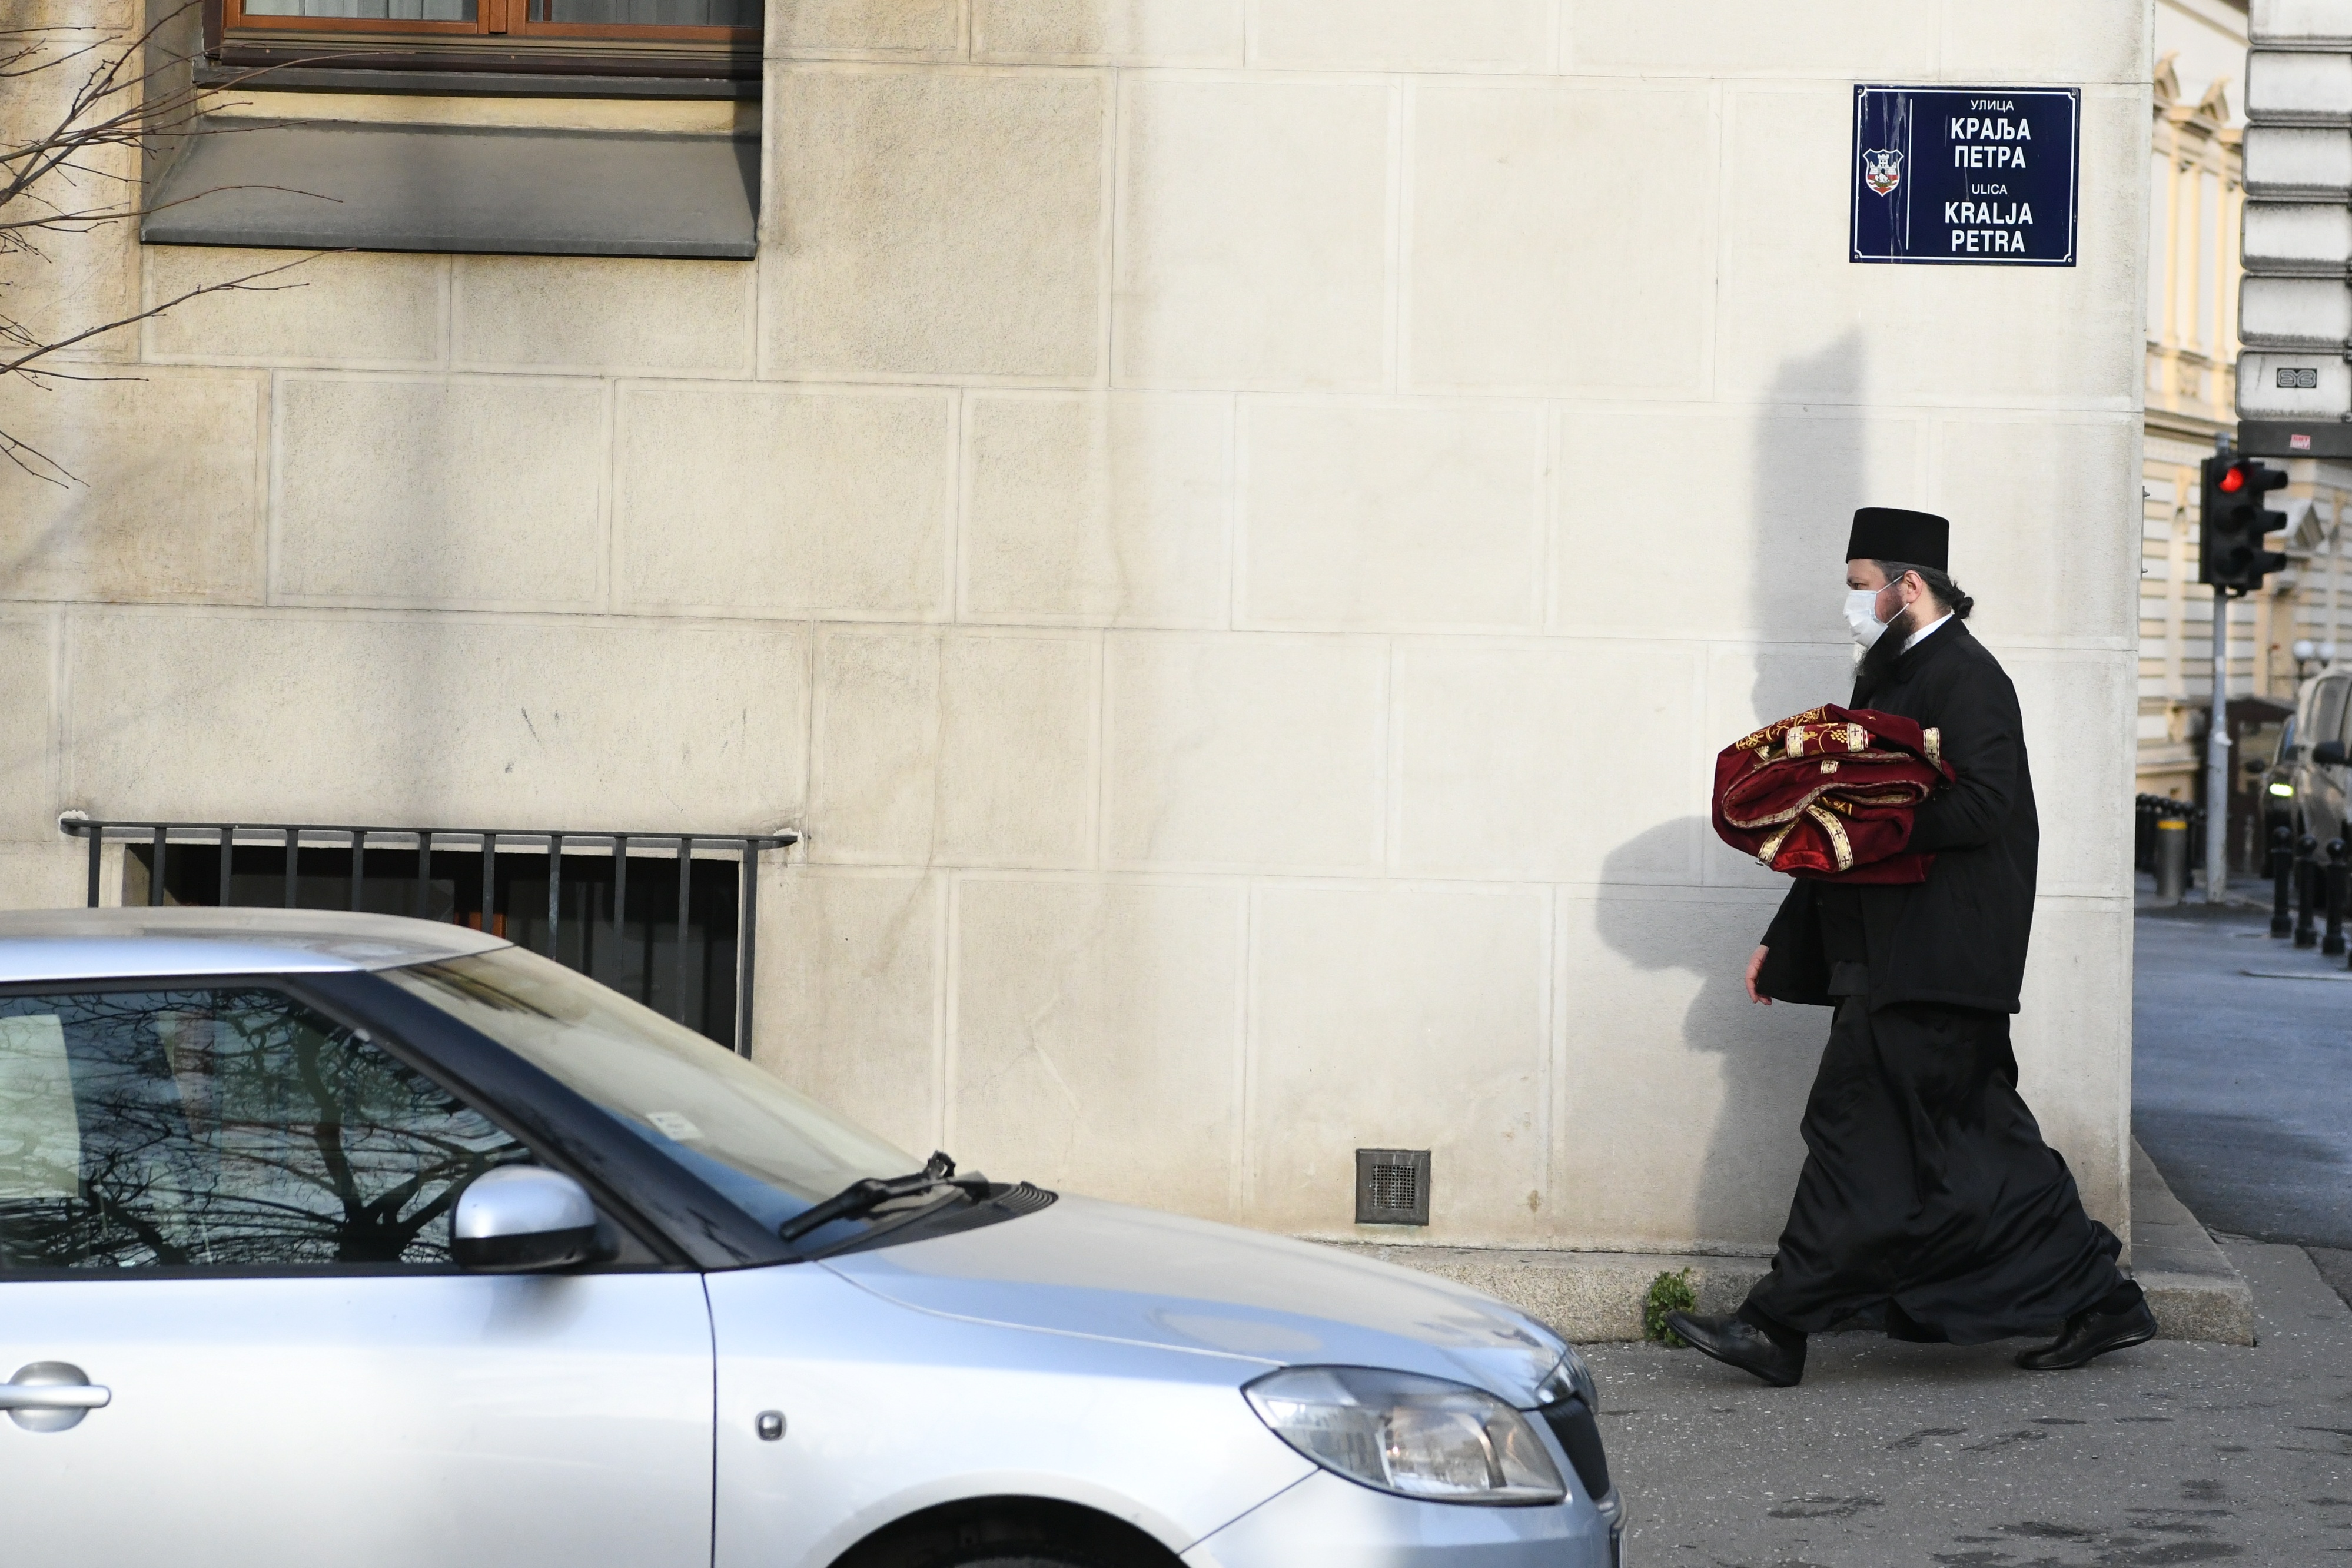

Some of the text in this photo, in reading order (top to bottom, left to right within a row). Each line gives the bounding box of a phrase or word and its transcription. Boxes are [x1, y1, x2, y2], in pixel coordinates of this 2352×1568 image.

[1970, 99, 2014, 113] УЛИЦА
[1951, 117, 2031, 141] КРАЉА
[1954, 145, 2026, 168] ПЕТРА
[1972, 184, 2008, 195] ULICA
[1945, 202, 2033, 225] KRALJA
[1952, 230, 2025, 253] PETRA
